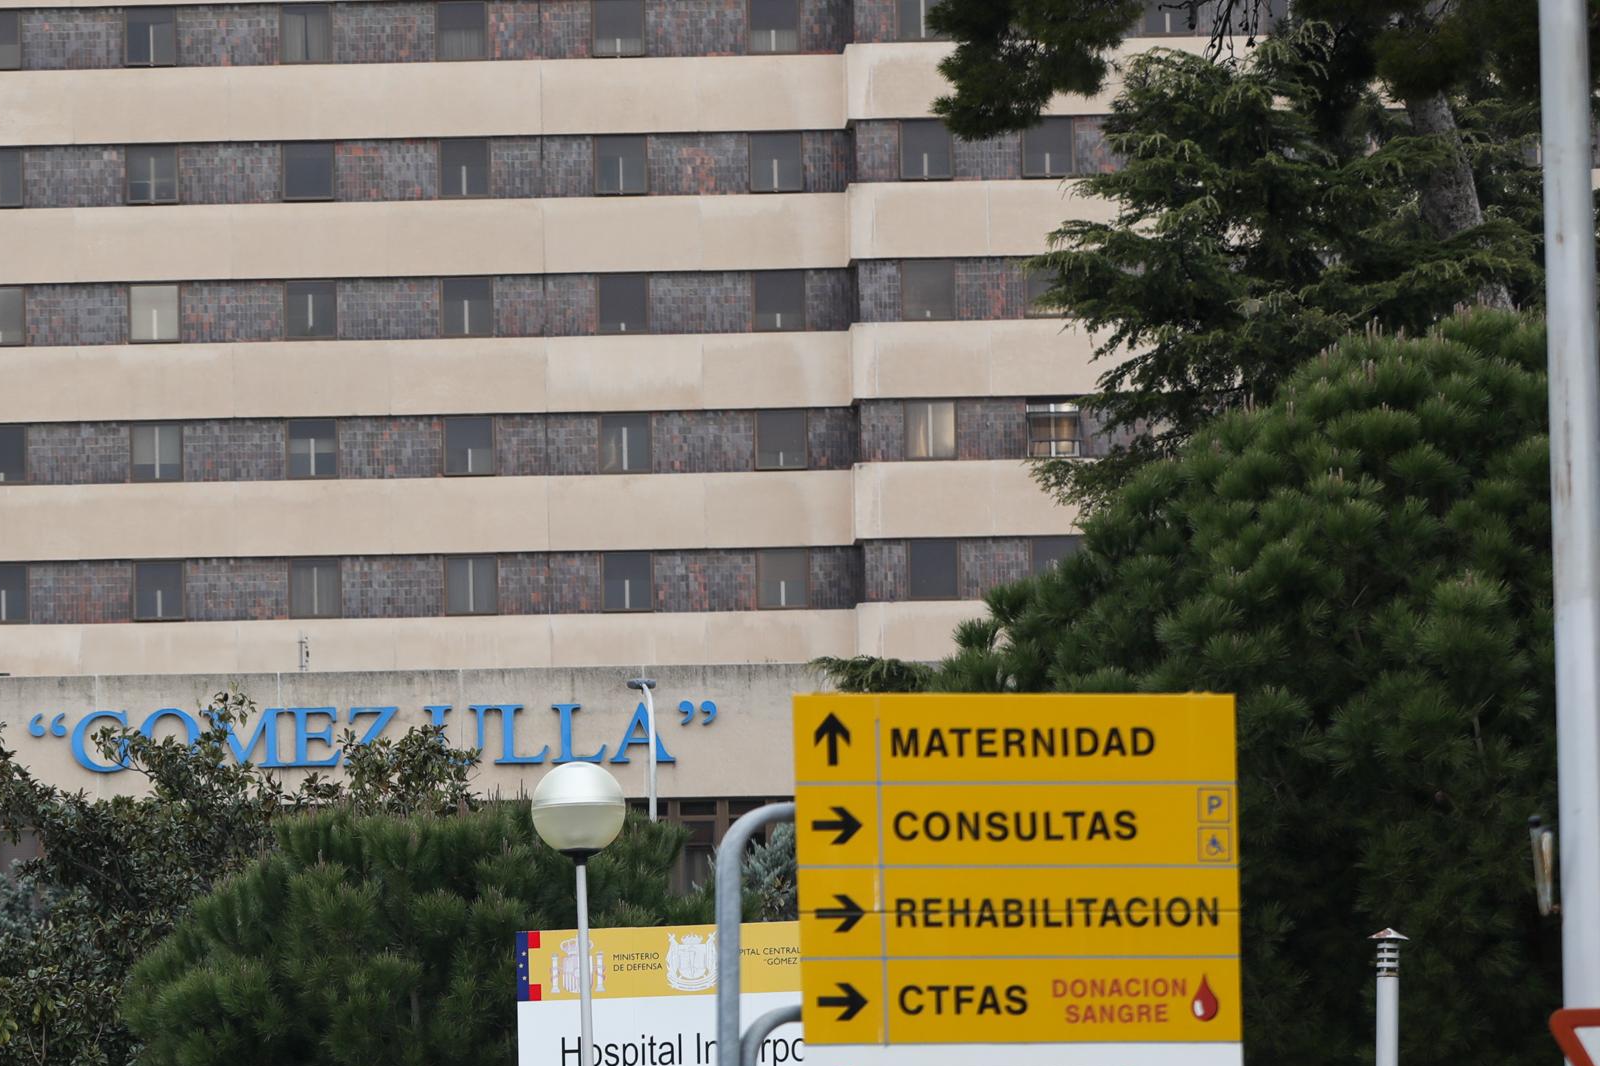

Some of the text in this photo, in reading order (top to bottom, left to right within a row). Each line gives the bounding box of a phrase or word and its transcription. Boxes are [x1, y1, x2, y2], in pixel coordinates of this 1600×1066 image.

[890, 727, 1157, 758] MATERNIDAD
[893, 810, 1138, 842] CONSULTAS
[895, 897, 1220, 928] REHABILITACION
[613, 952, 660, 961] MINISTERIO
[613, 962, 663, 972] DE DEFENSA
[898, 985, 1029, 1016] CTFAS
[1052, 978, 1188, 998] DONACION
[1065, 1003, 1169, 1024] SANGRE
